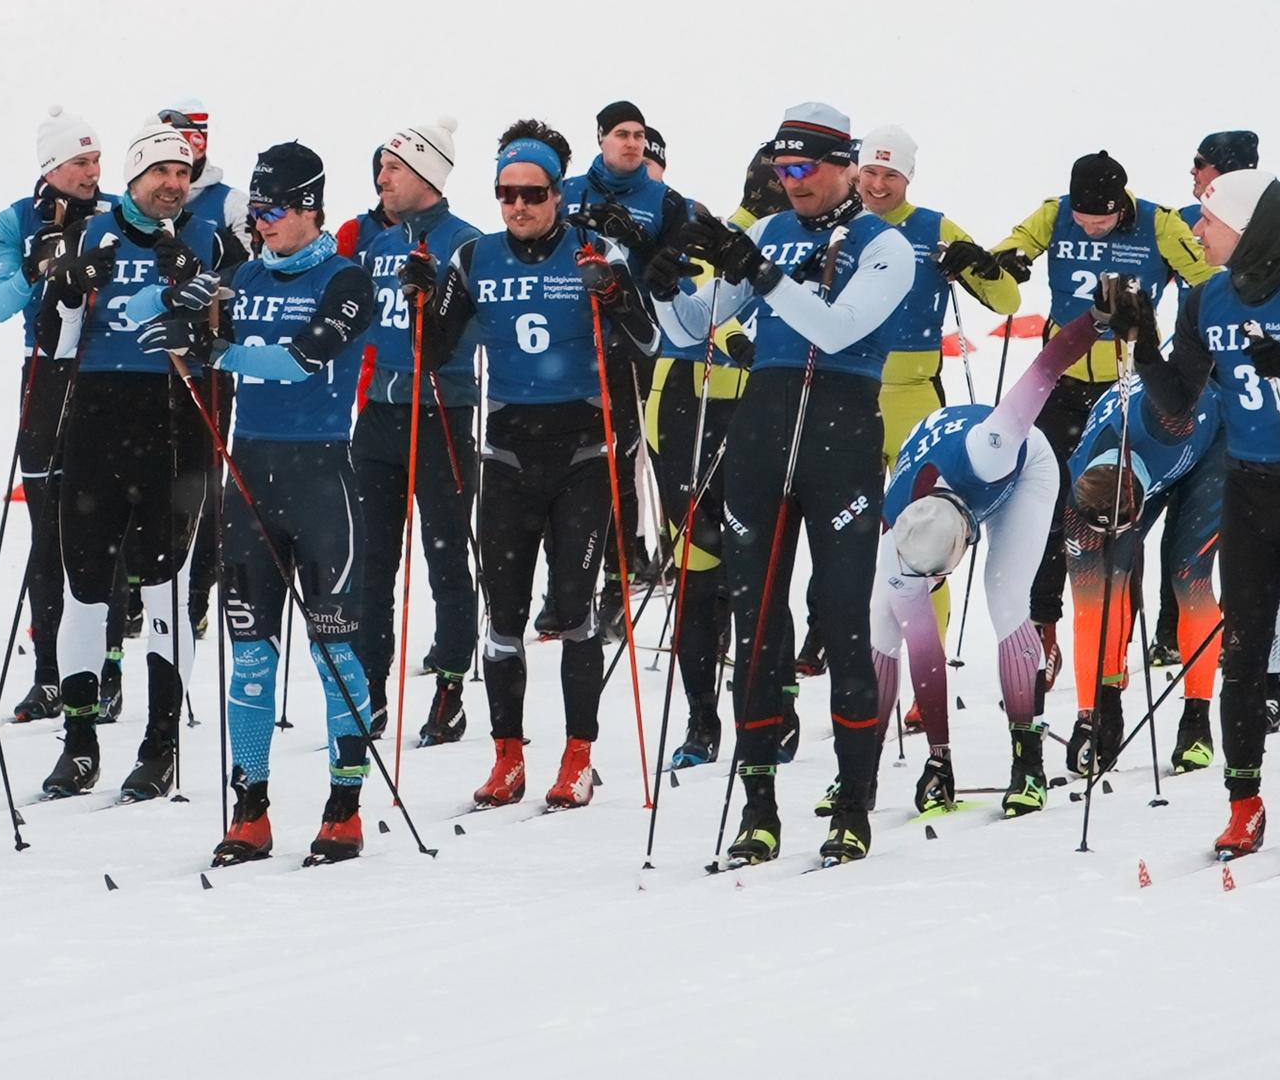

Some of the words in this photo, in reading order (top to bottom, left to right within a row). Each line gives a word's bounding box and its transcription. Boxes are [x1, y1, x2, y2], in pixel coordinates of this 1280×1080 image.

[1056, 240, 1108, 261] RIF
[1112, 242, 1151, 252] Rådgivende
[113, 260, 154, 285] IF
[372, 254, 407, 277] RIF
[1111, 257, 1142, 265] Forening
[439, 279, 454, 316] CRAFT
[477, 276, 538, 303] RIF
[233, 293, 284, 321] RIF
[378, 288, 410, 329] 25
[515, 313, 550, 354] 6
[582, 537, 593, 569] CRAFT
